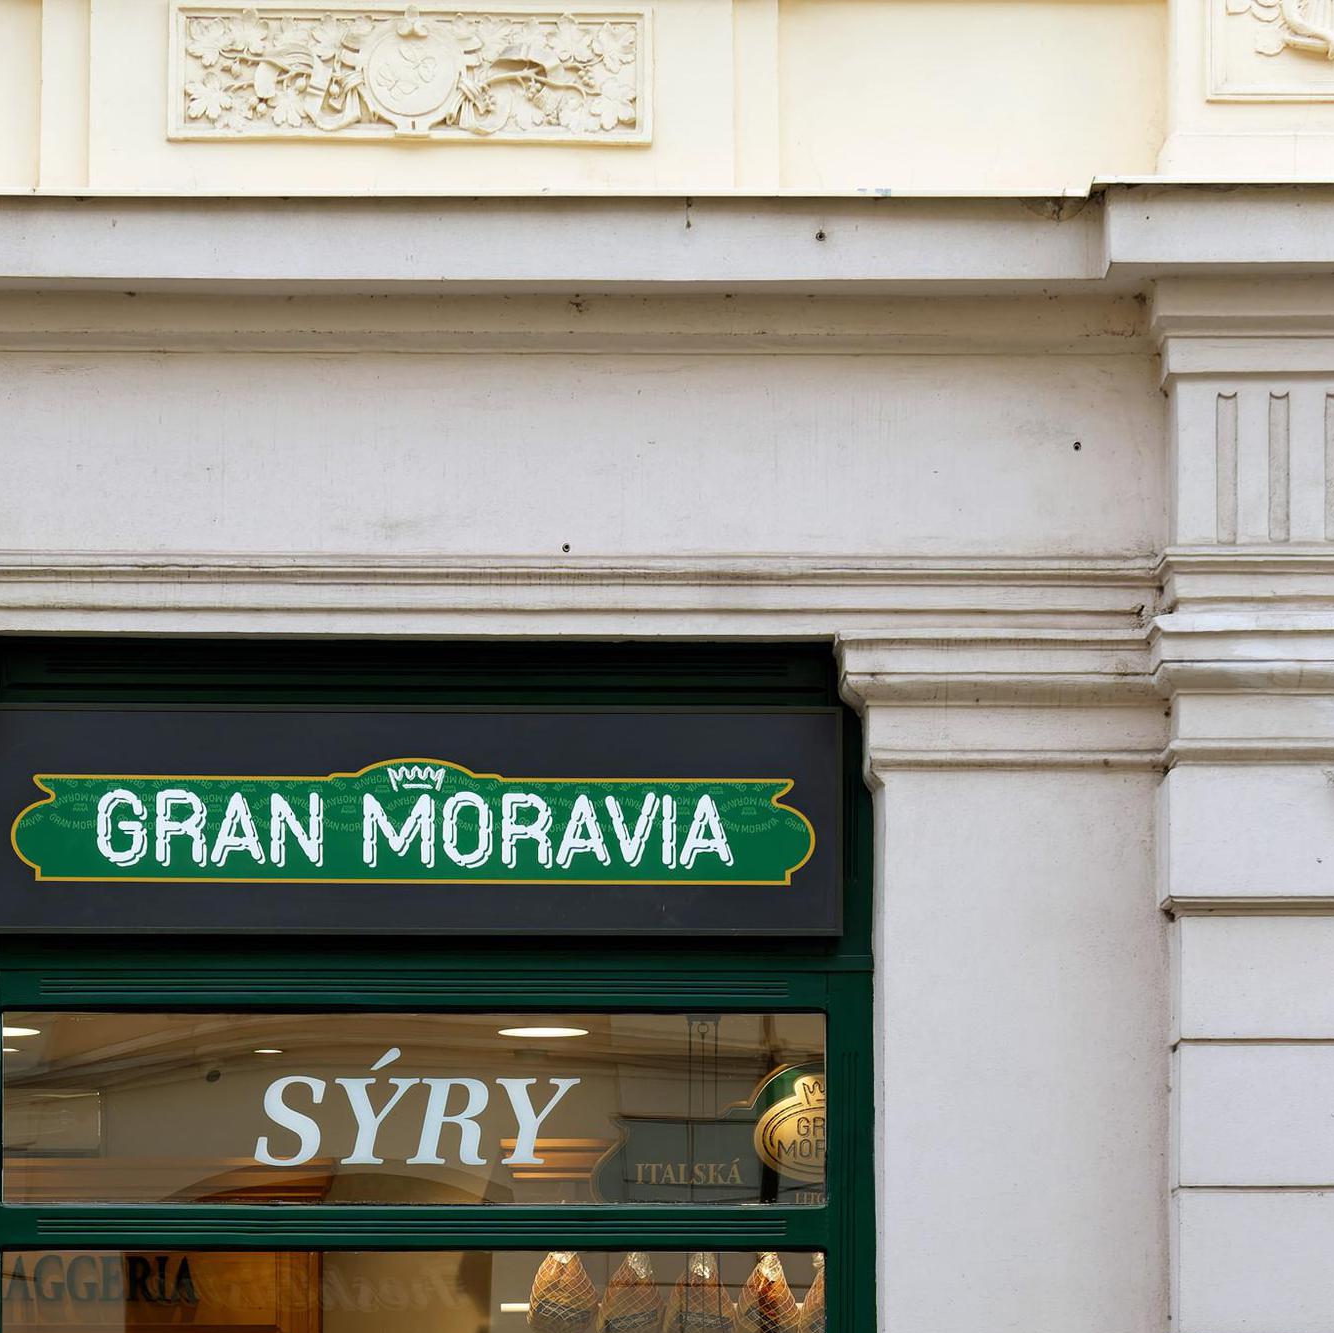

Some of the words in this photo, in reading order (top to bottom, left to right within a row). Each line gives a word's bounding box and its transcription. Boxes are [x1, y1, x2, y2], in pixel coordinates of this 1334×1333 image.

[96, 788, 323, 867] GRAN
[361, 791, 734, 869] MORAVIA
[253, 1047, 581, 1167] SÝRY
[634, 1158, 743, 1185] ITALSKÁ
